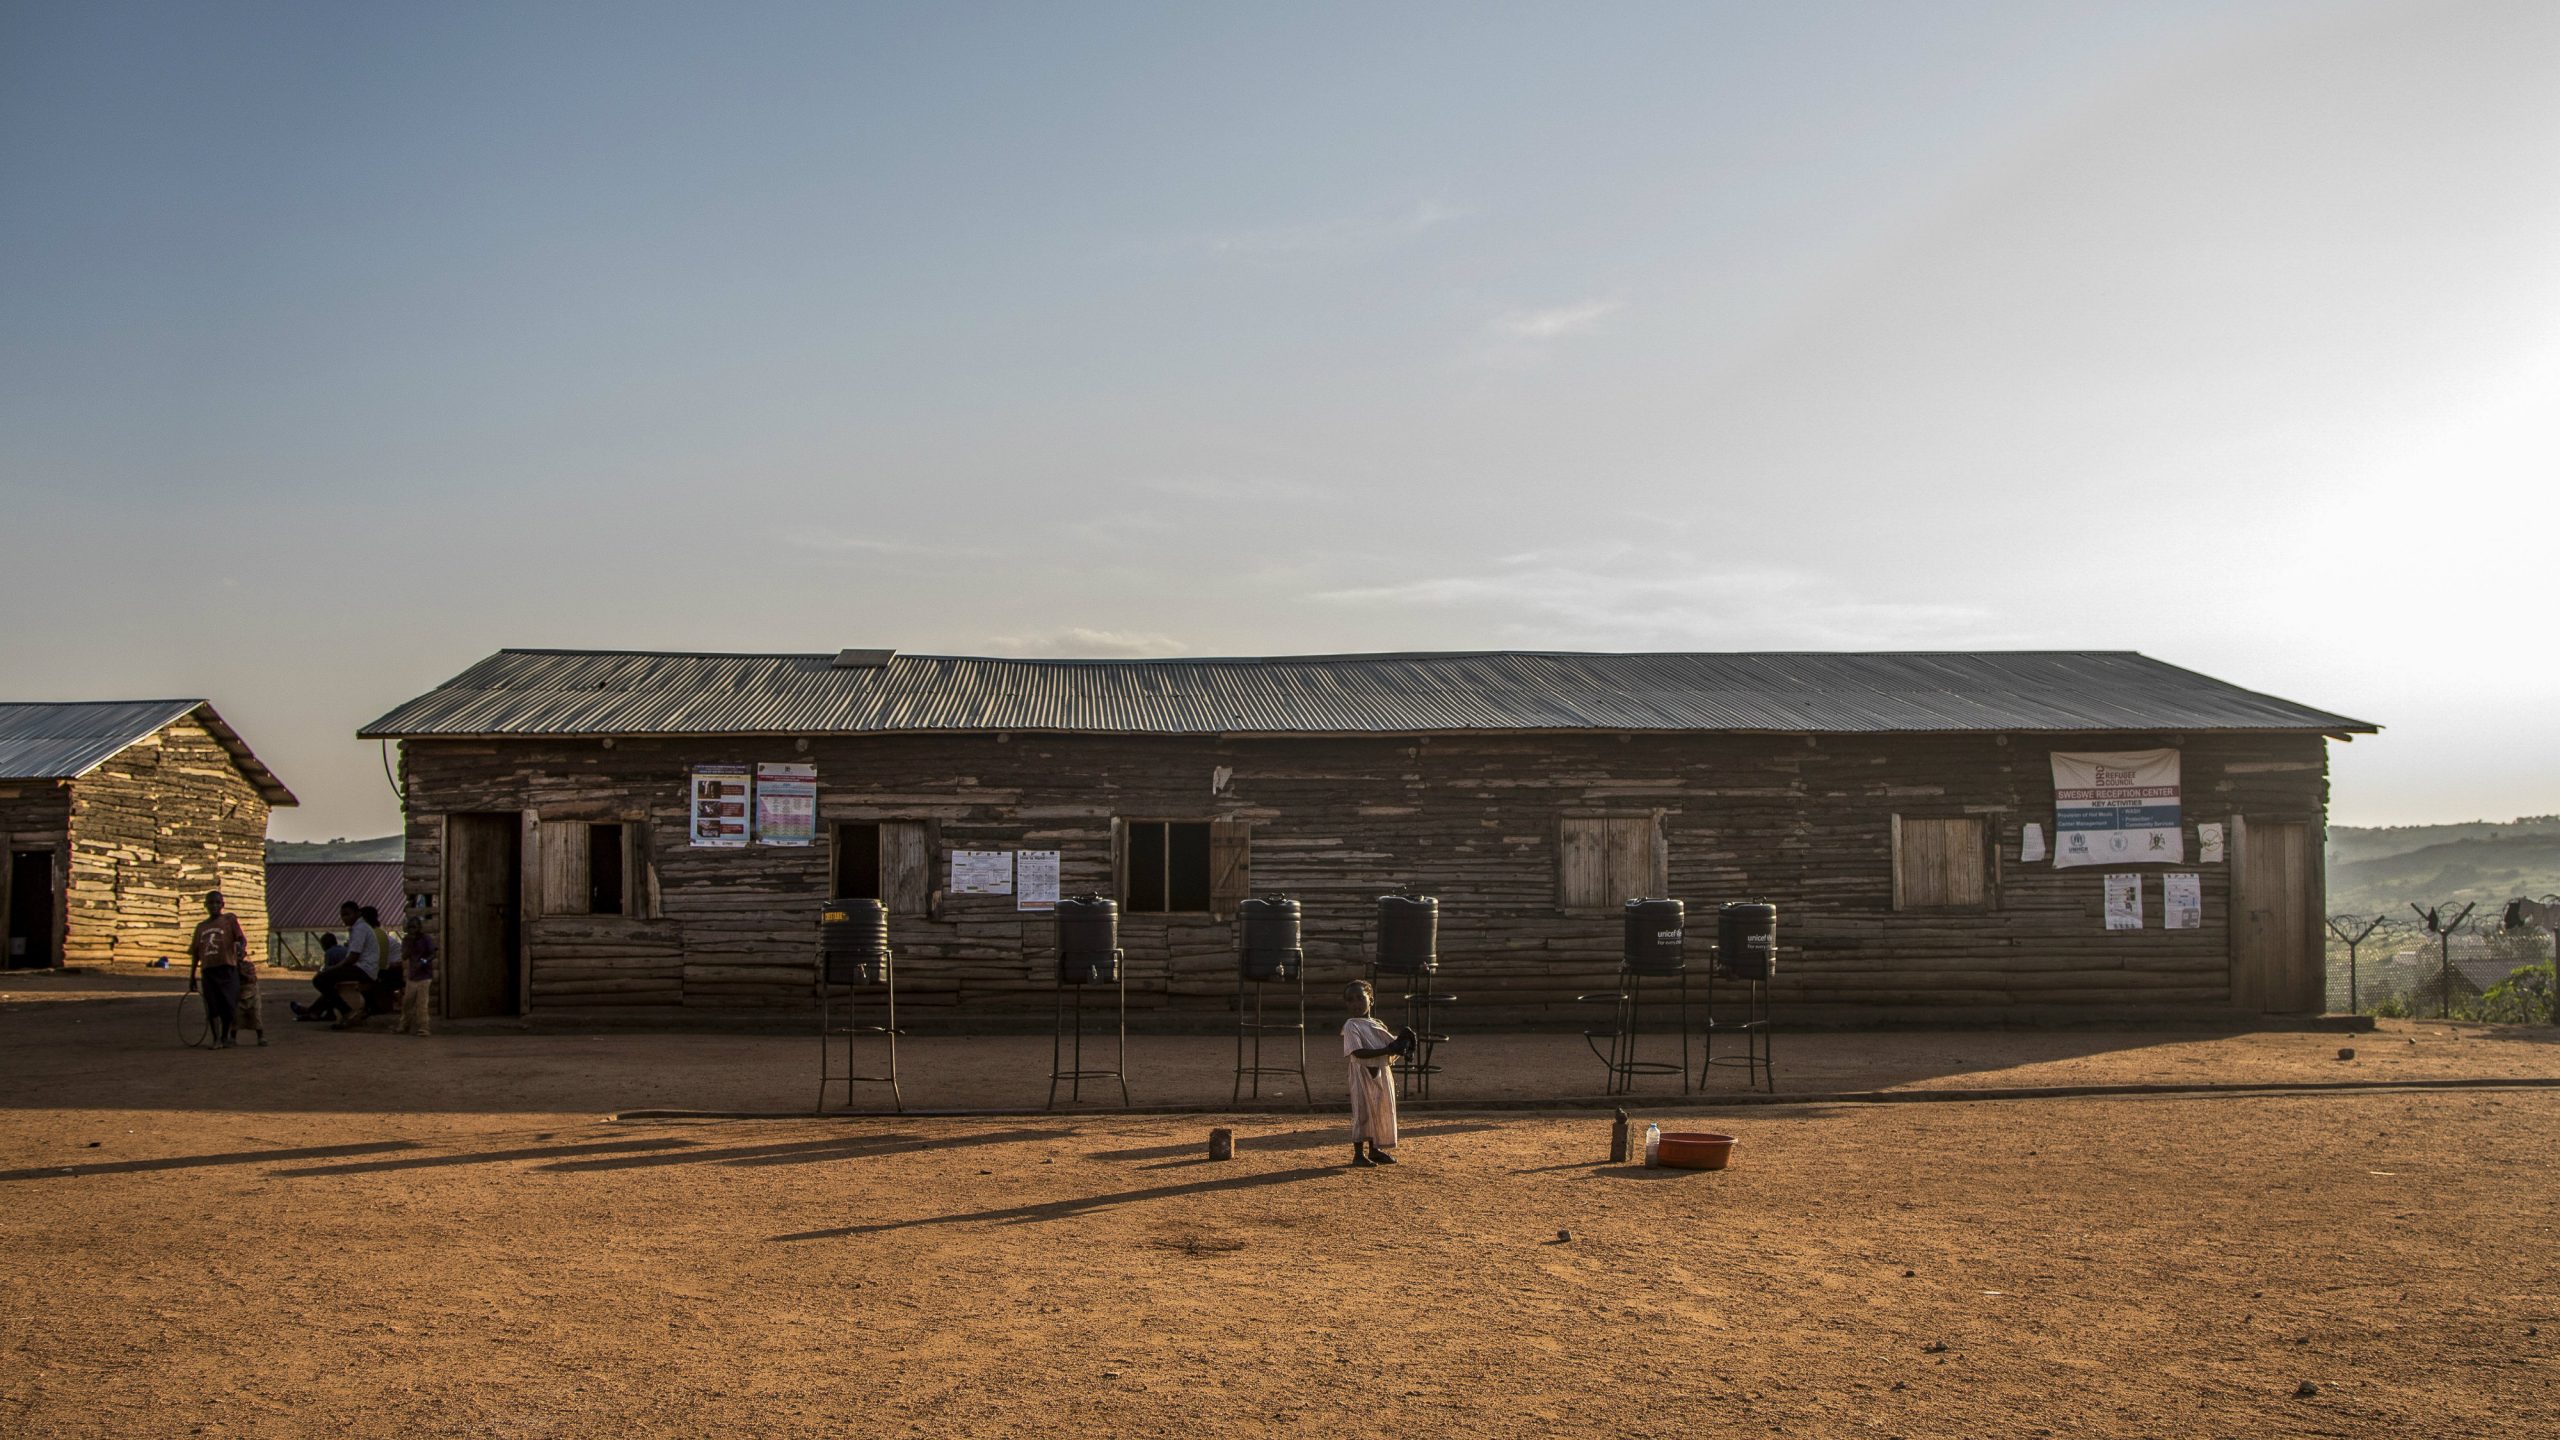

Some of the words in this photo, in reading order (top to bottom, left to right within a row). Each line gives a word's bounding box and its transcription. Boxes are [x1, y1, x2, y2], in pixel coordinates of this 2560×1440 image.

[2058, 790, 2095, 799] SWESWE
[2096, 790, 2141, 798] RECEPTION
[2142, 788, 2173, 796] CENTER
